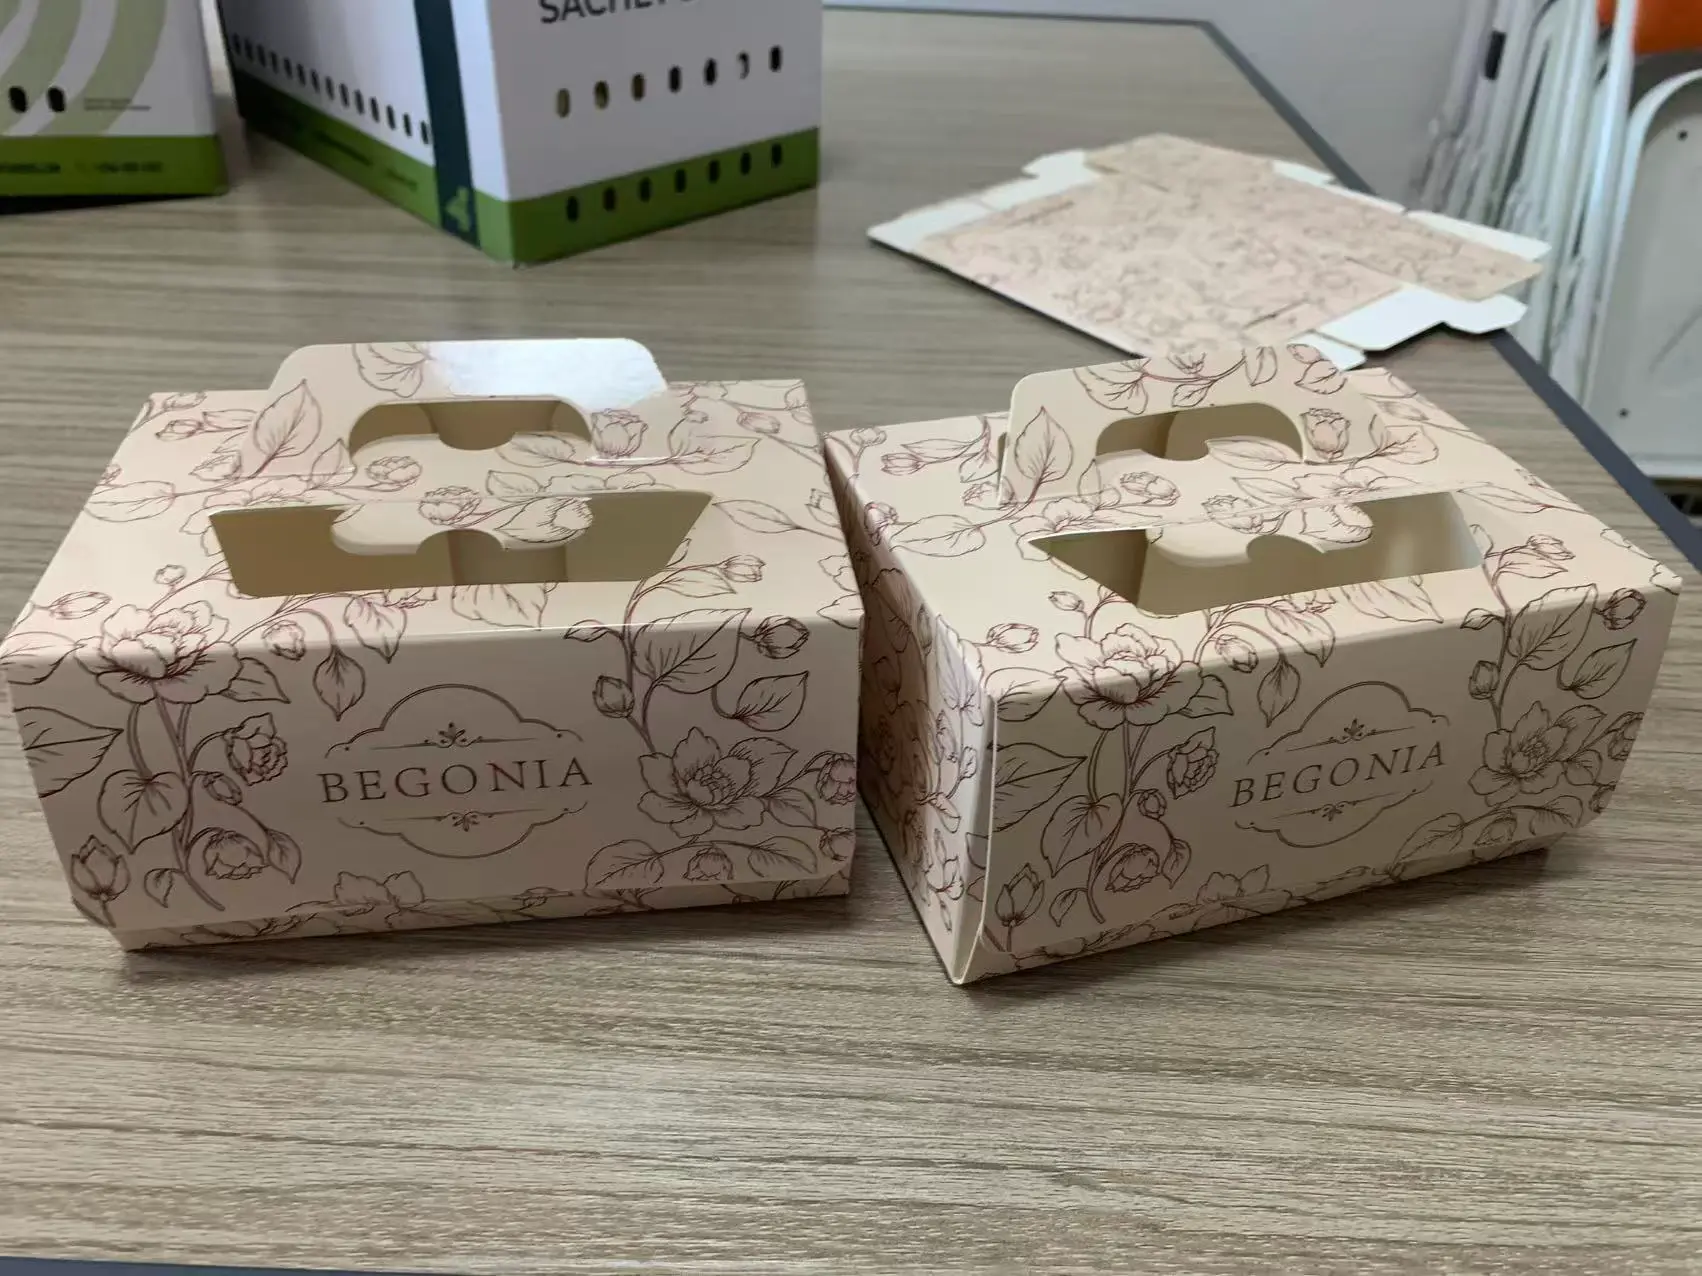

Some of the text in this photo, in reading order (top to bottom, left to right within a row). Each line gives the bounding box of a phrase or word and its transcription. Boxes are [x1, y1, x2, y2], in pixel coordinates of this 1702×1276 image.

[540, 0, 666, 24] SAC
[316, 757, 593, 803] BEGONIA
[1229, 741, 1445, 808] BEGONIA
